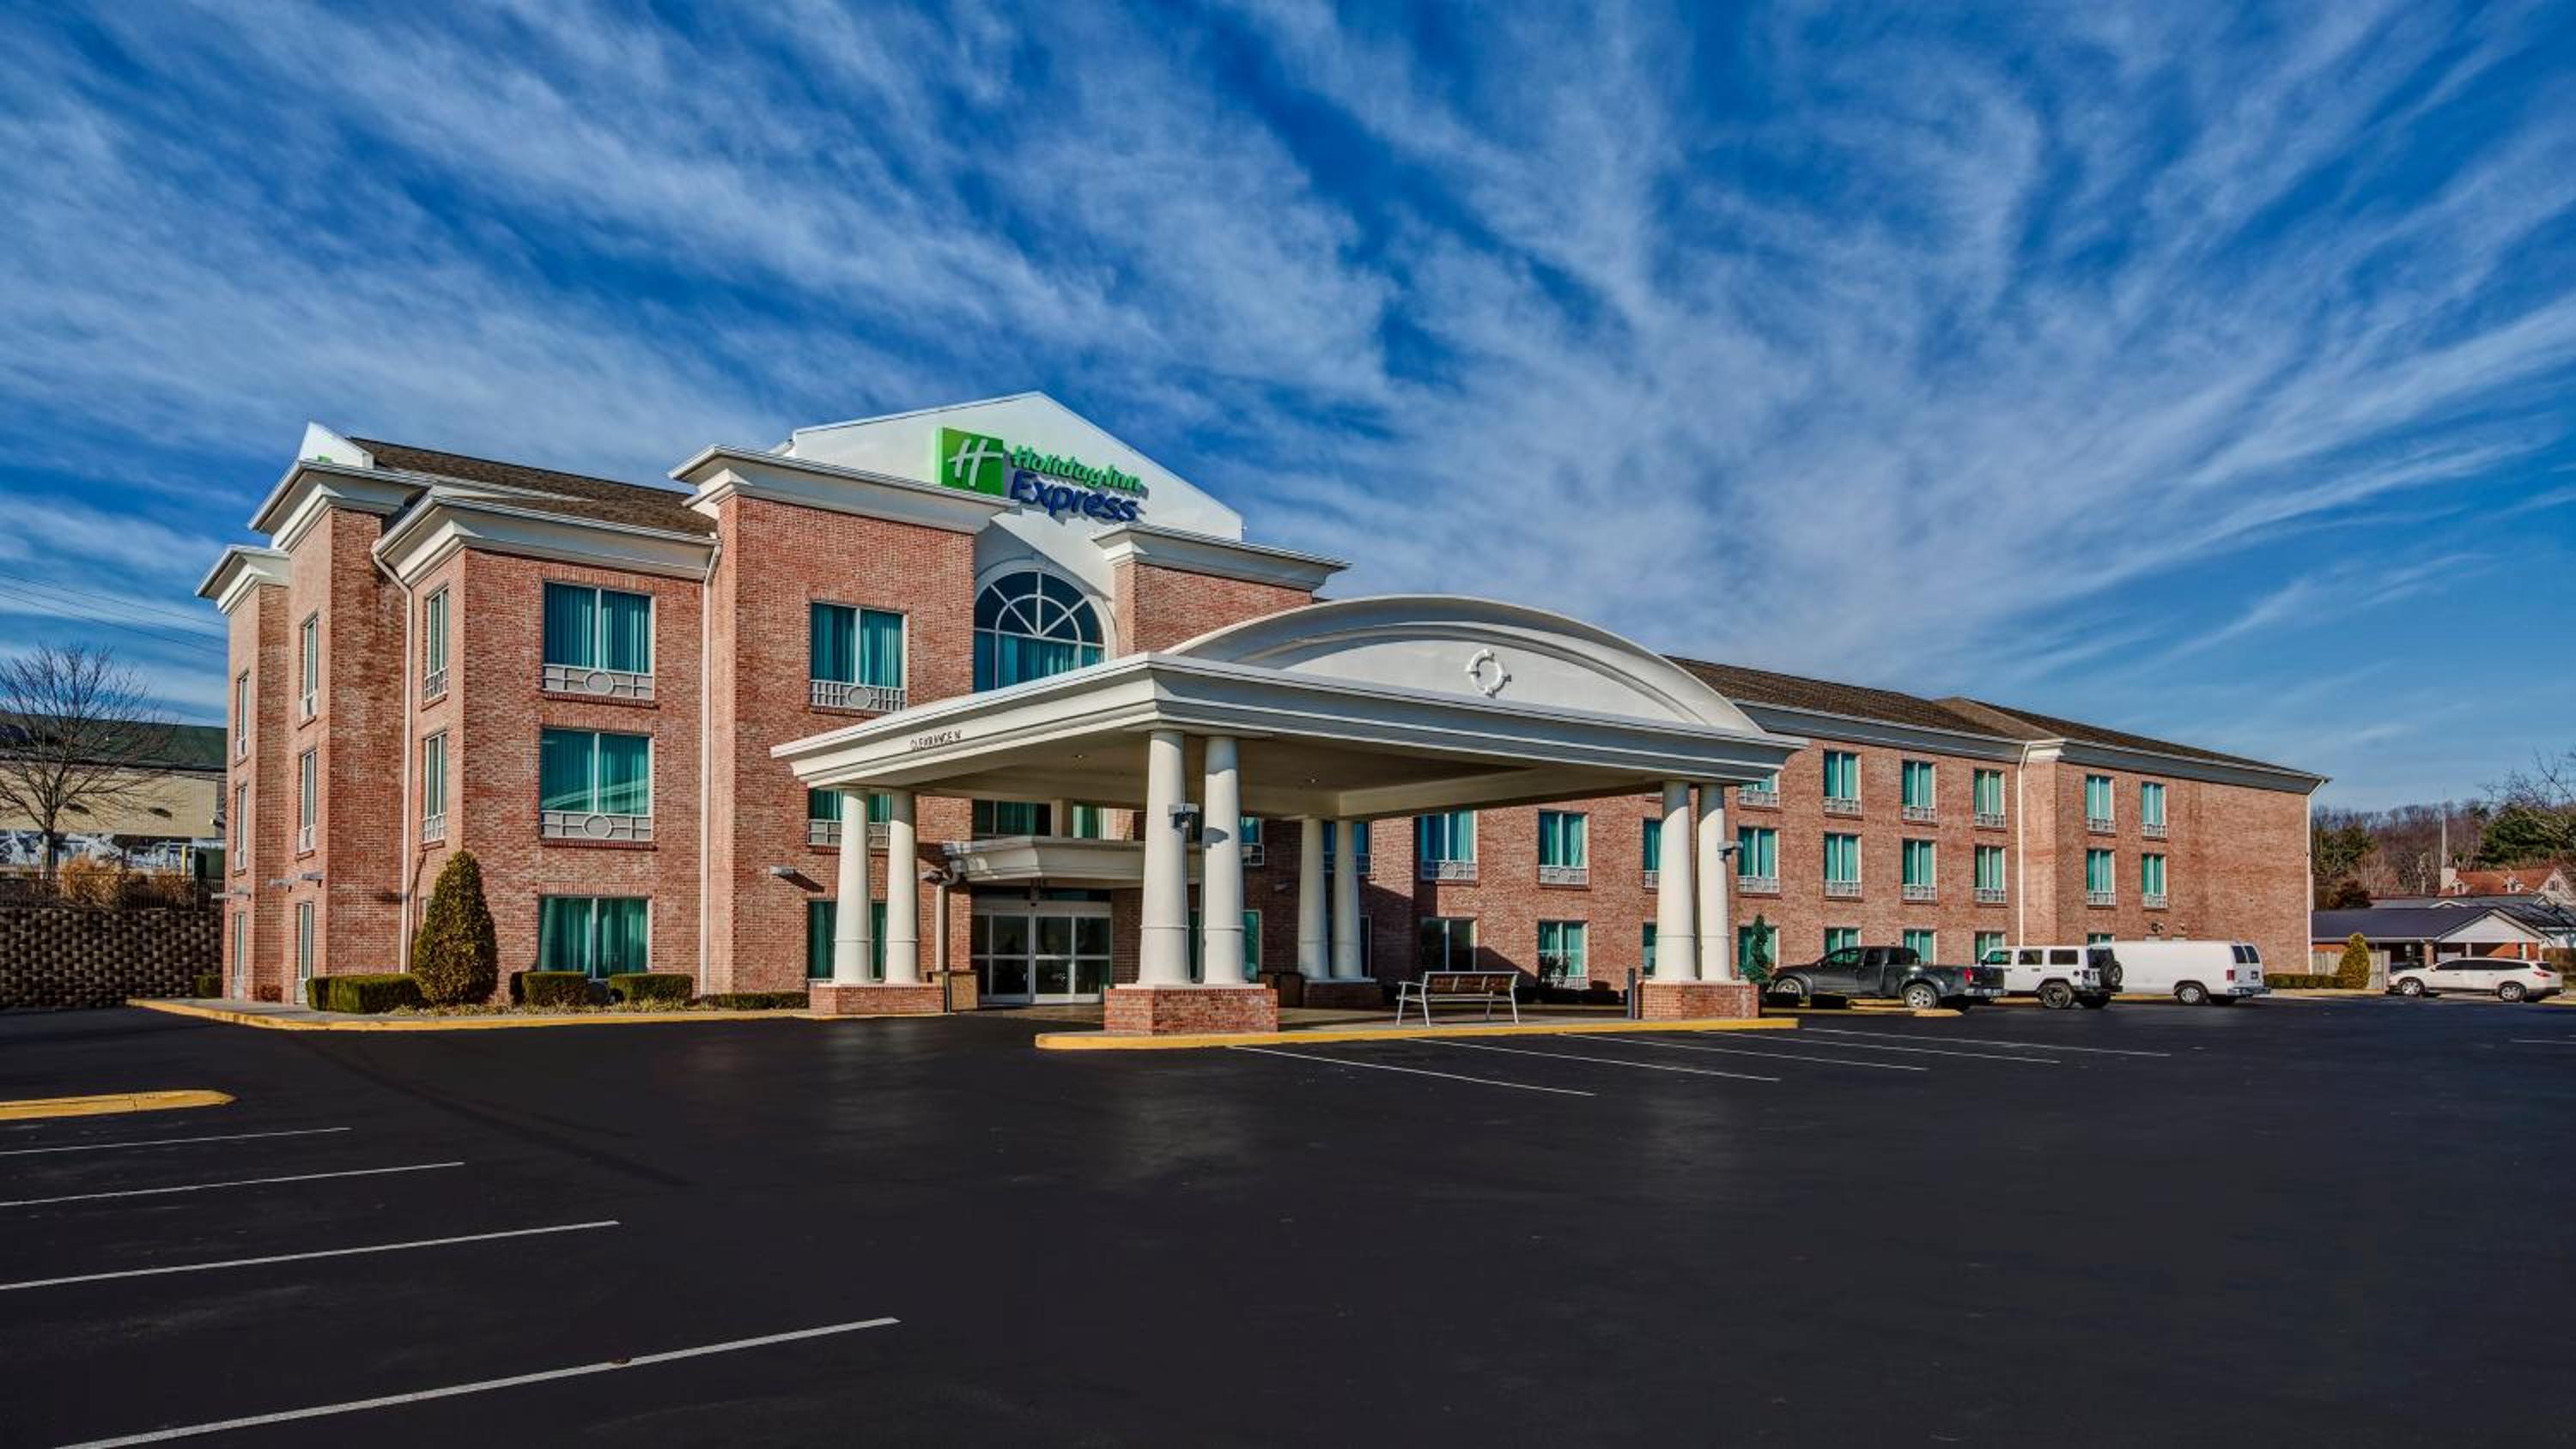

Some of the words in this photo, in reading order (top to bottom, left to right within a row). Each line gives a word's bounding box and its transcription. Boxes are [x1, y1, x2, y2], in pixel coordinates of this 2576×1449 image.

[1012, 446, 1103, 488] Holiday
[1103, 464, 1142, 492] Inn
[1010, 470, 1139, 522] Express
